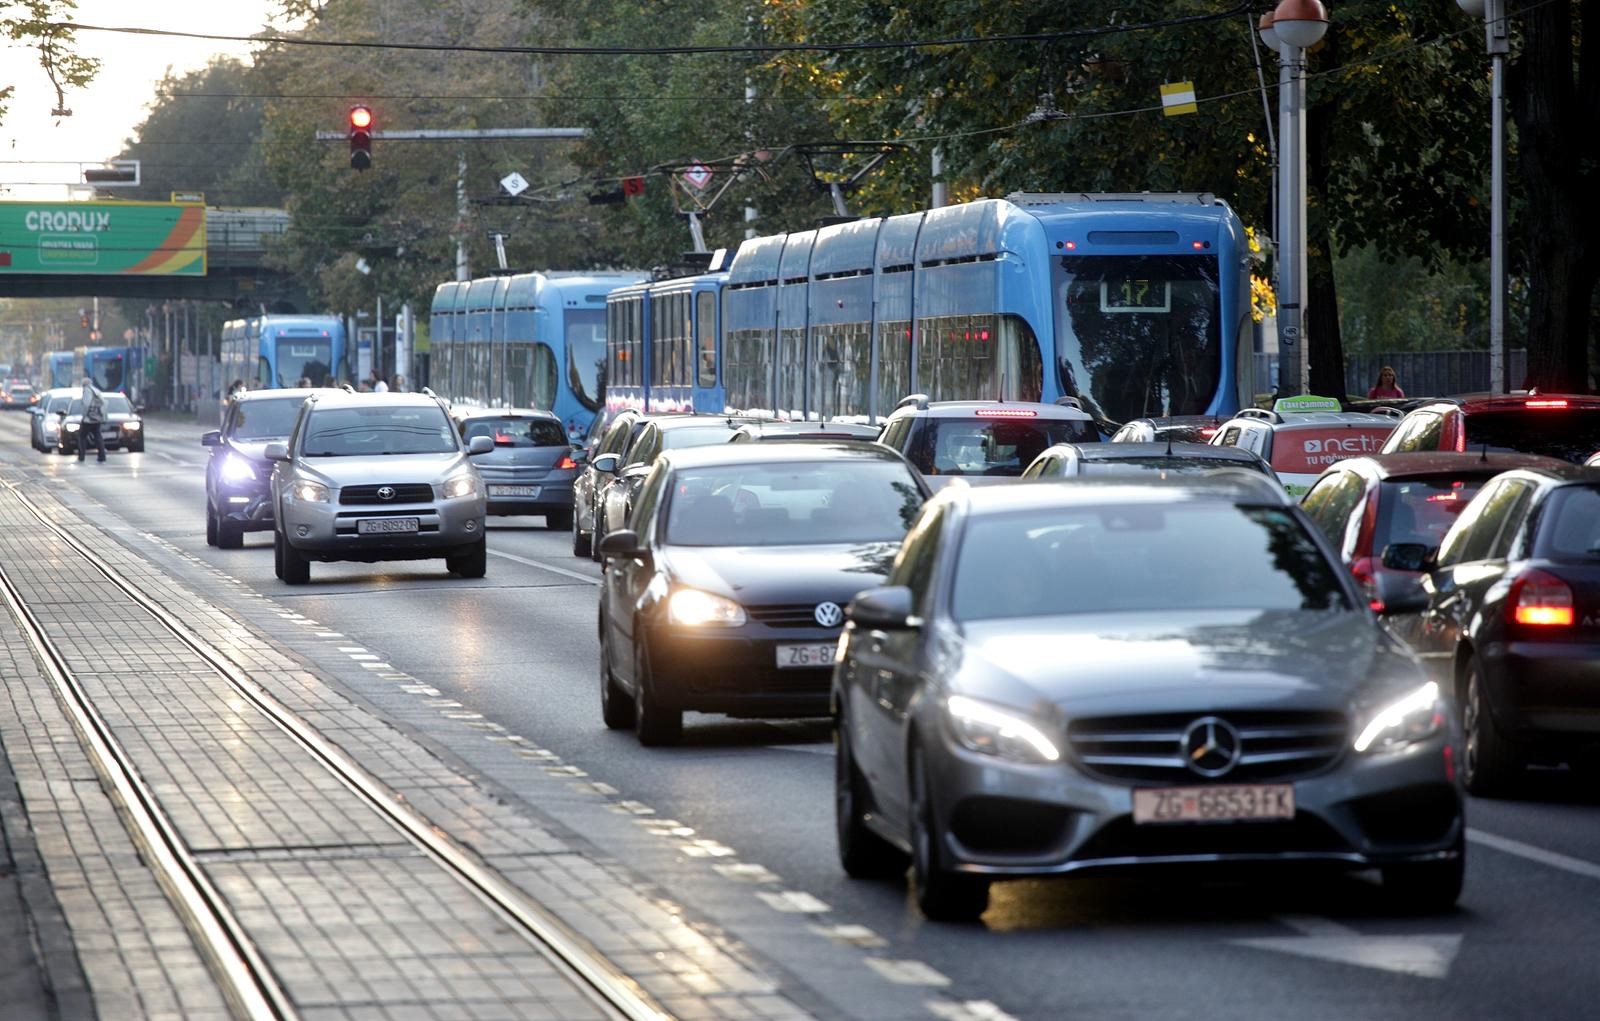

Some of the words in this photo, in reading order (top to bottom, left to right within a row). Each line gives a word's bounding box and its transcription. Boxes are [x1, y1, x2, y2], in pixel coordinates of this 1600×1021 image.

[511, 179, 520, 189] S
[25, 210, 111, 231] CRODUX
[1121, 279, 1149, 305] 17
[789, 647, 809, 664] ZG
[1153, 790, 1182, 818] ZG
